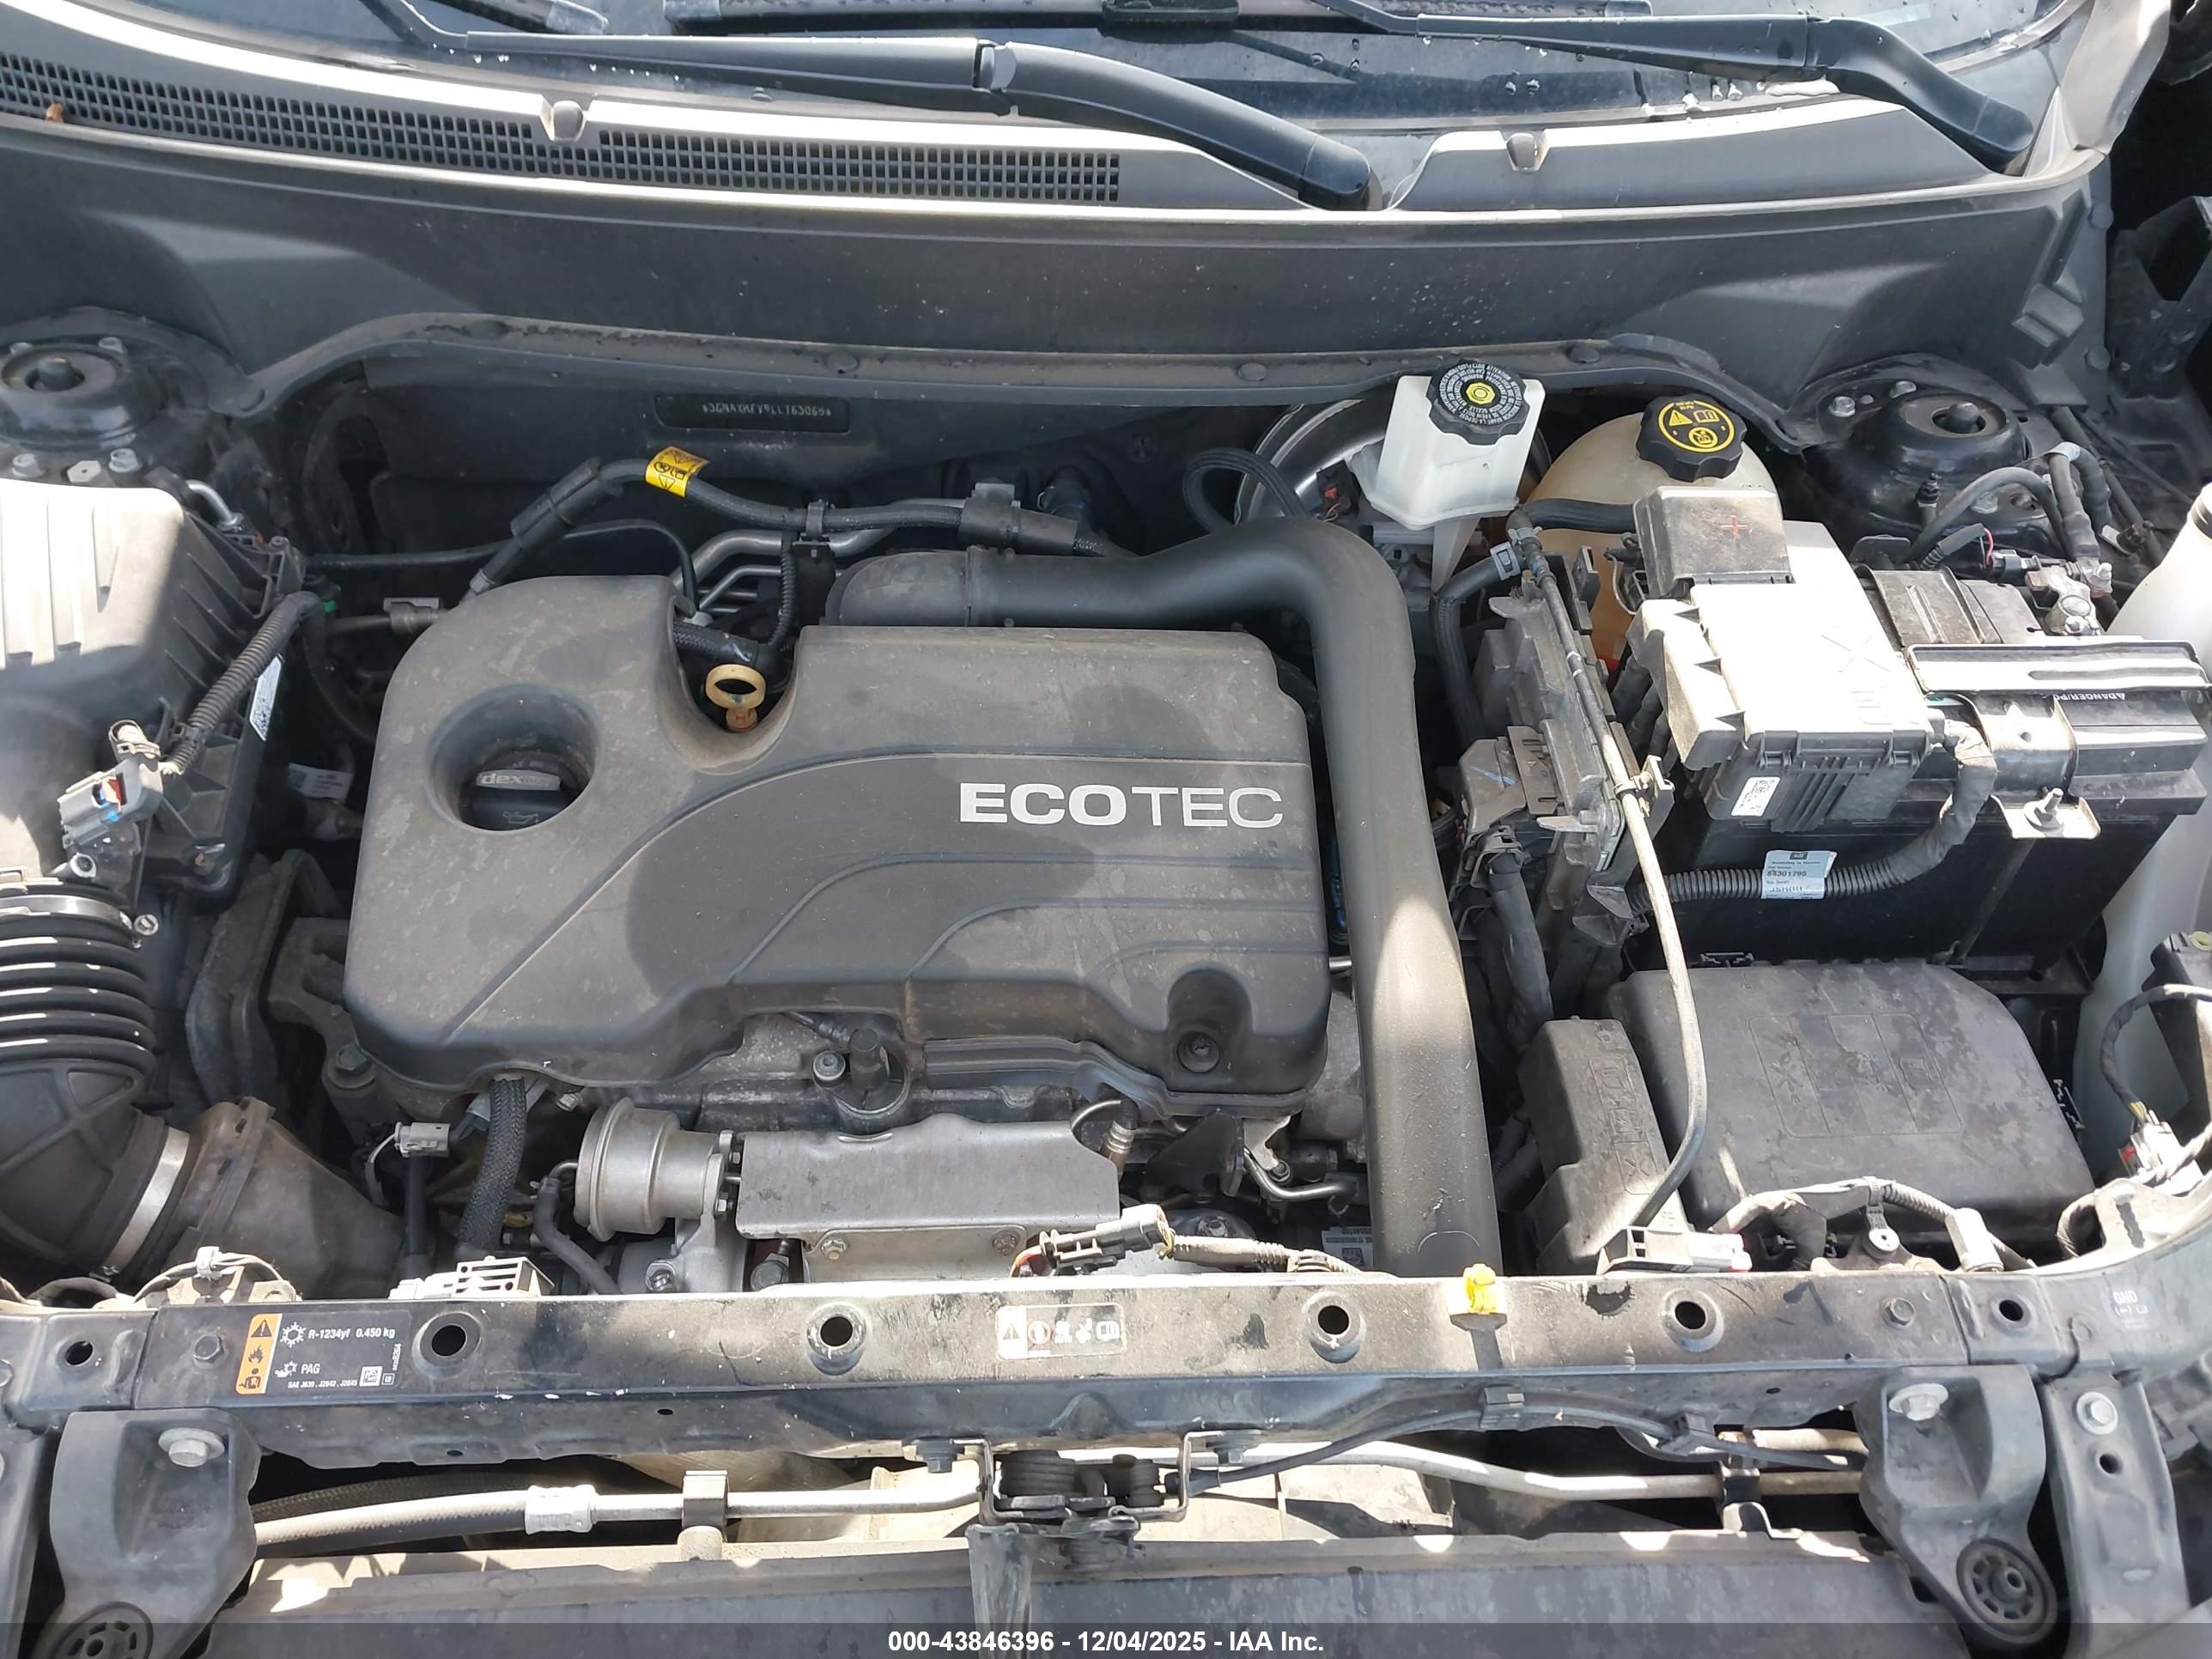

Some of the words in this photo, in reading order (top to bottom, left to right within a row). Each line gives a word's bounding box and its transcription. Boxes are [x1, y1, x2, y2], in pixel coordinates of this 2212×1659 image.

[960, 783, 1283, 829] ECOTEC
[2112, 1290, 2138, 1306] GND
[307, 1328, 350, 1340] R-1234yf
[356, 1328, 381, 1338] 0.450
[383, 1328, 396, 1340] kg
[301, 1363, 321, 1375] PAG
